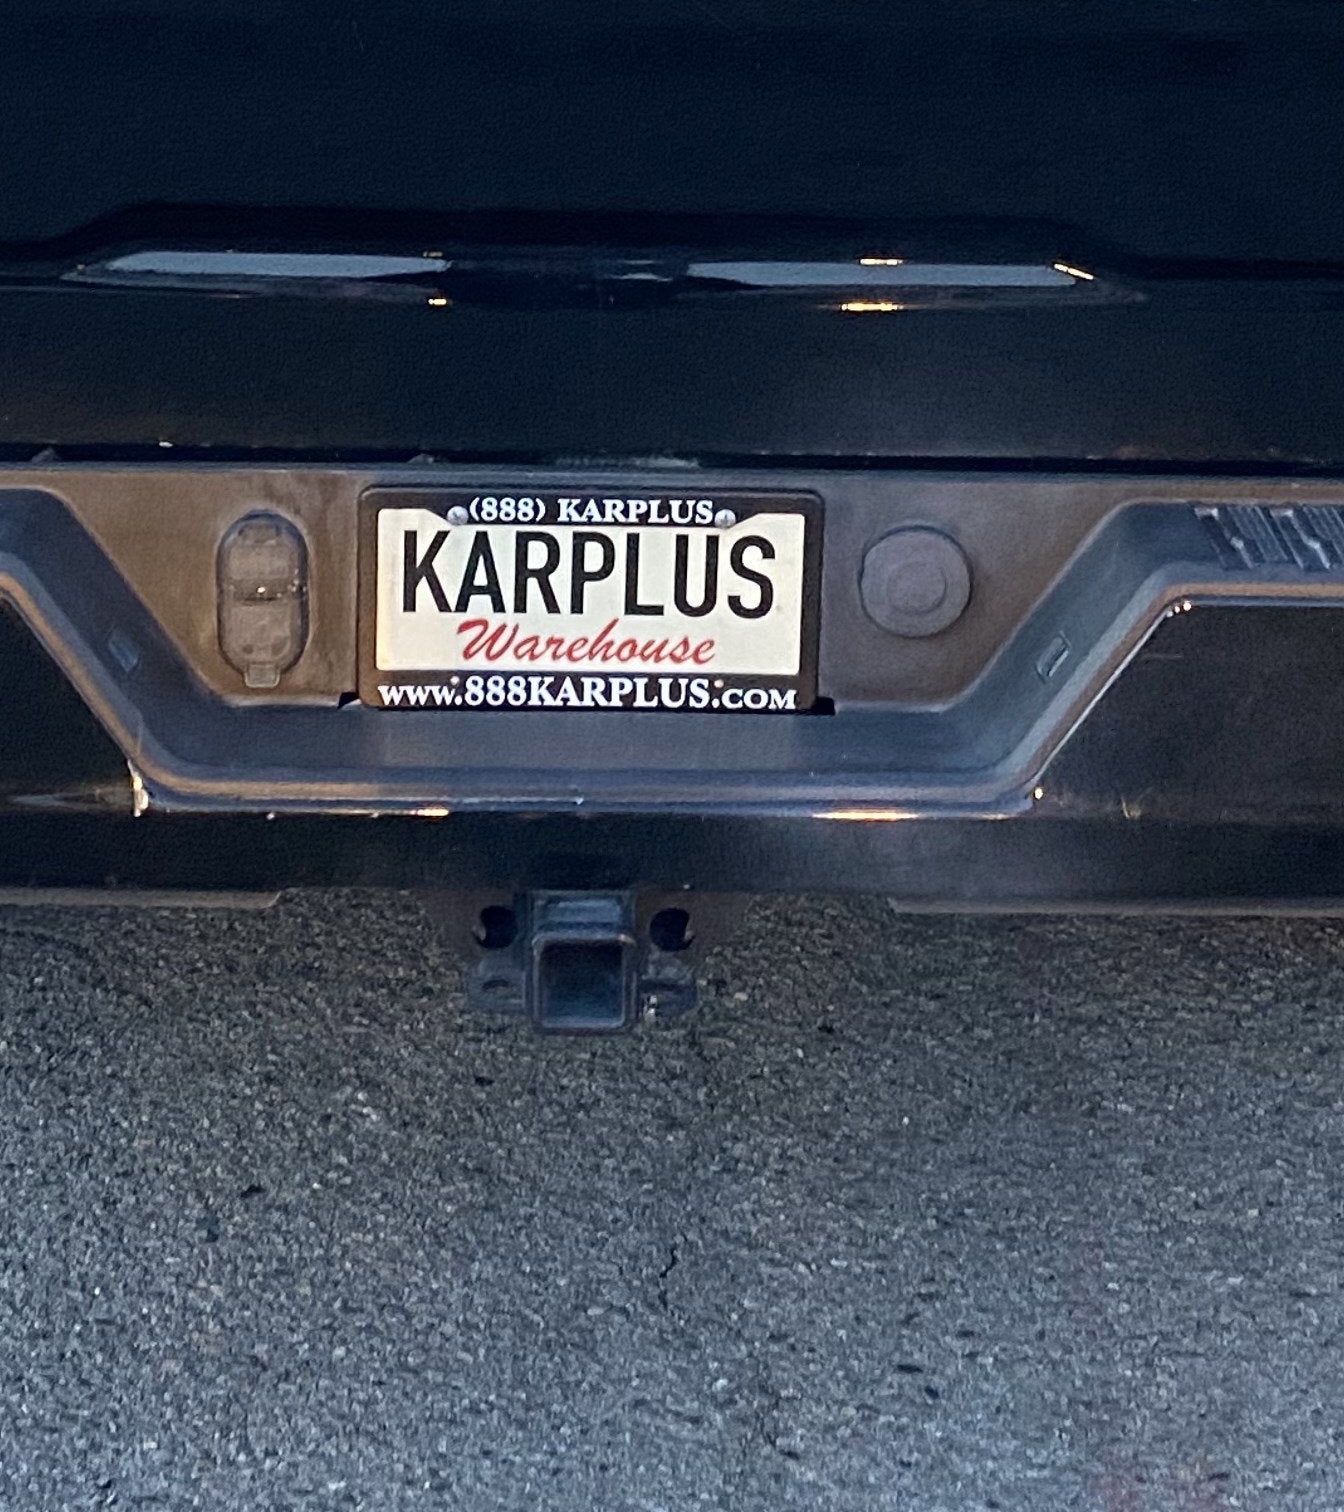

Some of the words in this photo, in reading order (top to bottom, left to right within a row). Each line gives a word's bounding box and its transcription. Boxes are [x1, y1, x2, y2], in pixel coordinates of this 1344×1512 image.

[469, 496, 546, 524] (888)
[557, 497, 714, 525] KARPLUS
[401, 529, 777, 619] KARPLUS
[455, 617, 716, 665] Warehouse
